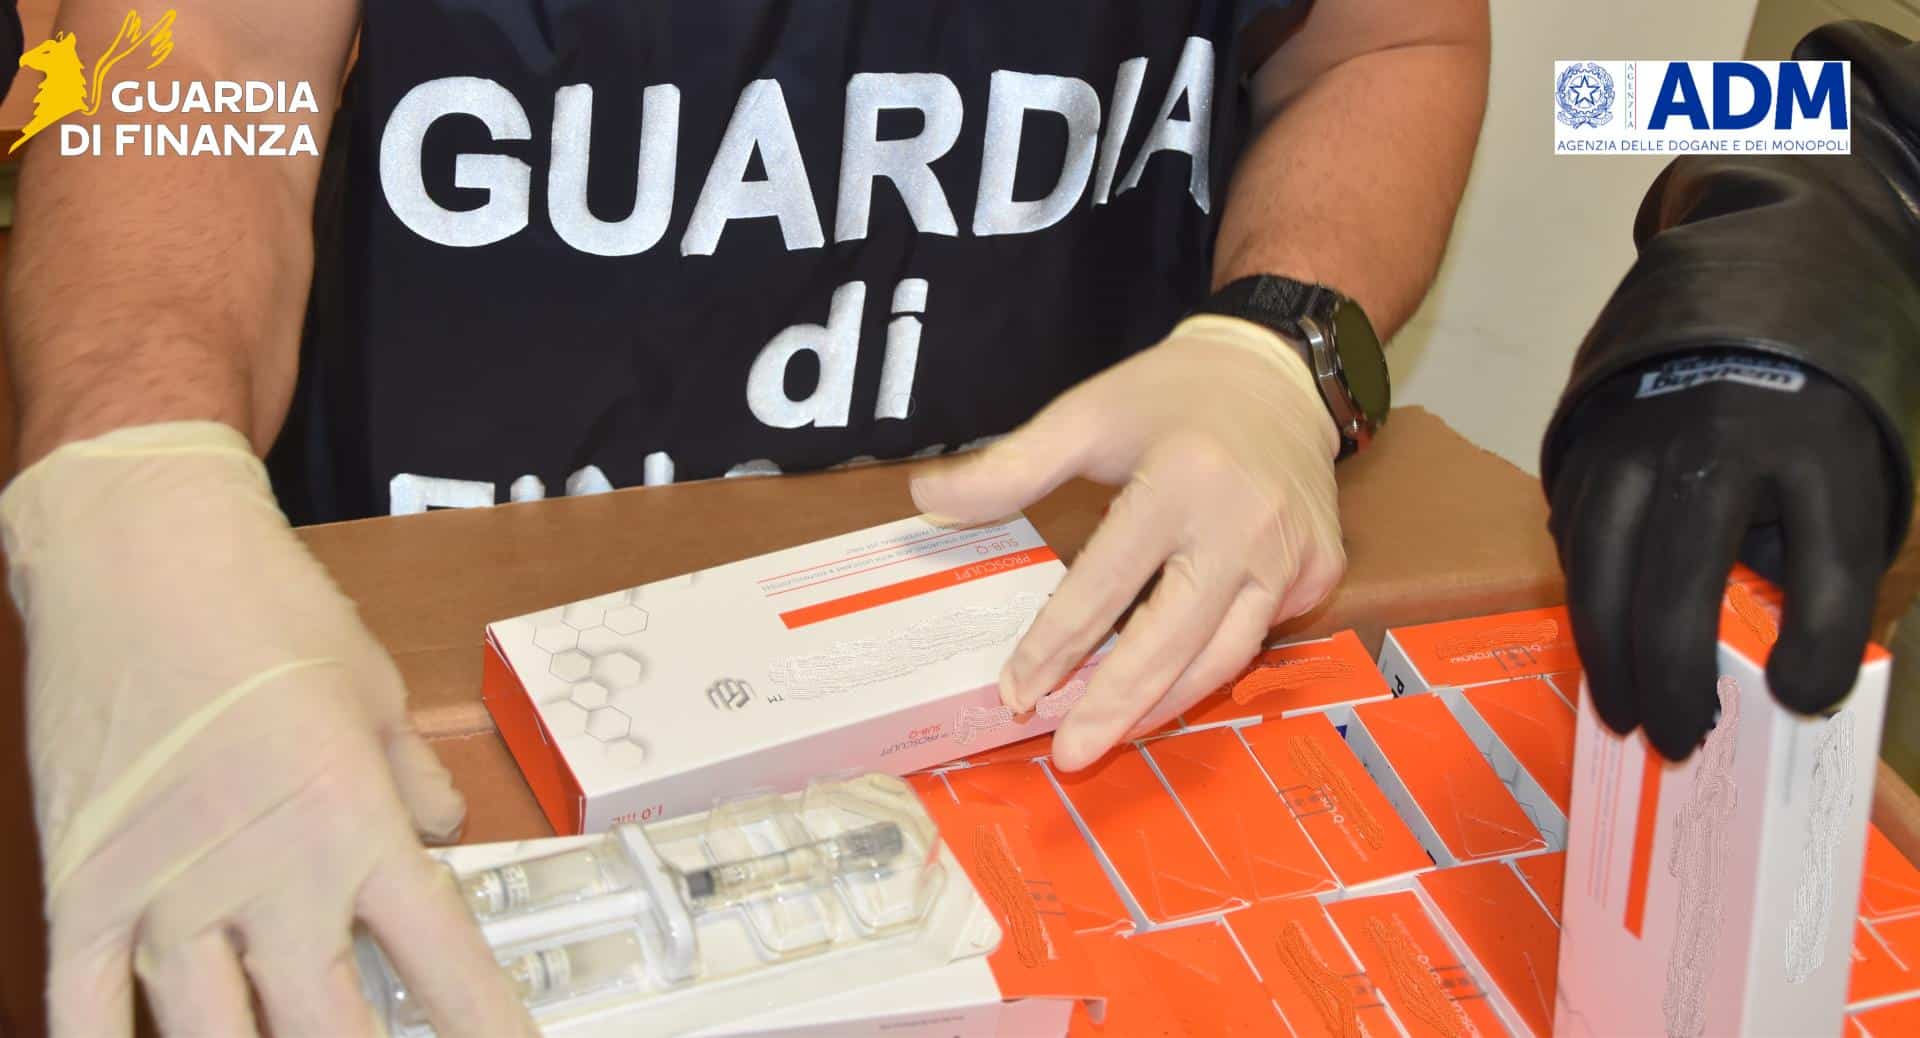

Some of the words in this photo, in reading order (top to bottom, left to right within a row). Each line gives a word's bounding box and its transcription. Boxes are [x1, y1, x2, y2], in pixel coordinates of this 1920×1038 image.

[379, 36, 1215, 257] GUARDIA
[746, 278, 928, 428] di
[954, 553, 1032, 581] PROSCULPT
